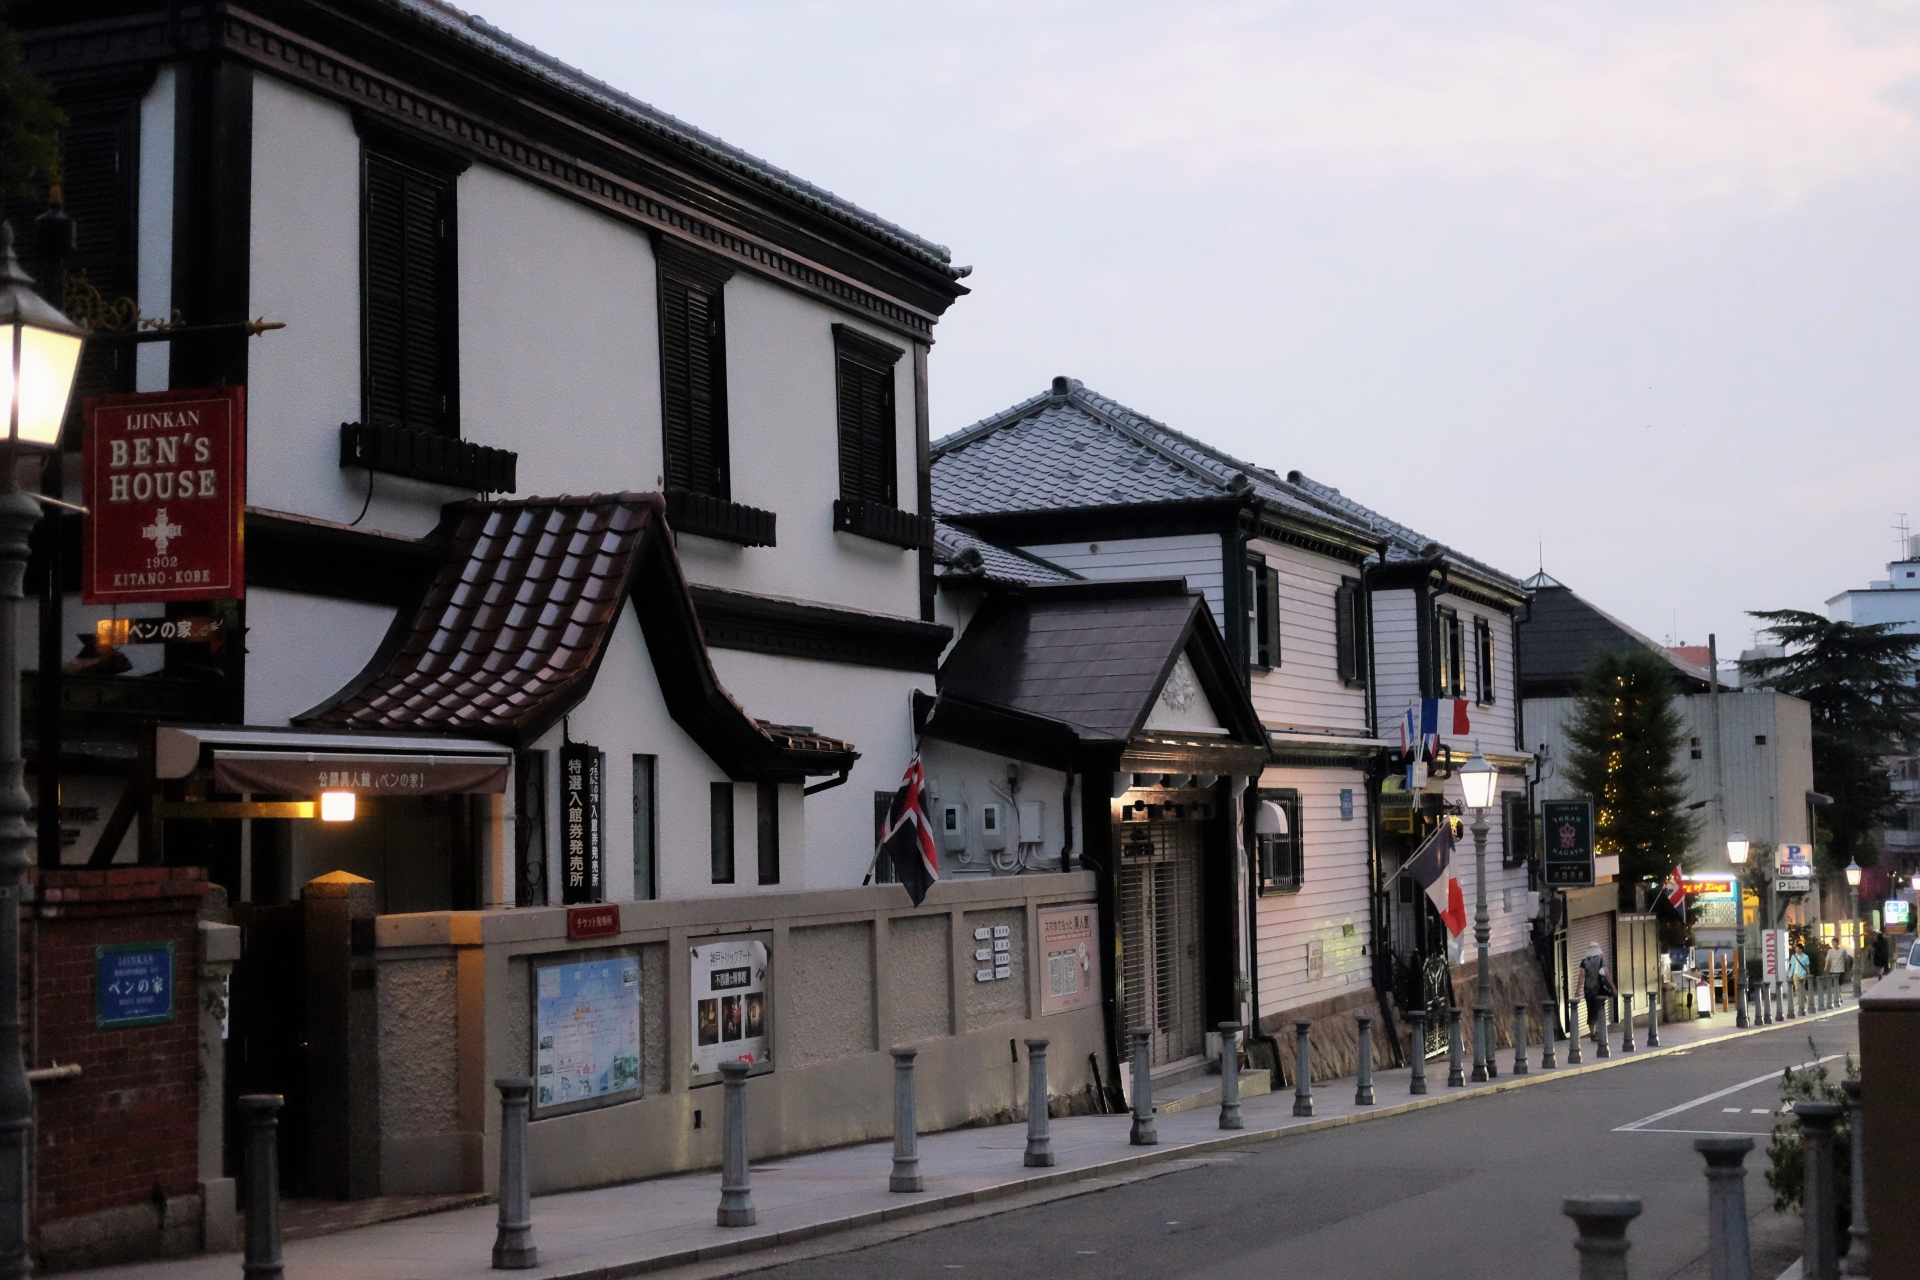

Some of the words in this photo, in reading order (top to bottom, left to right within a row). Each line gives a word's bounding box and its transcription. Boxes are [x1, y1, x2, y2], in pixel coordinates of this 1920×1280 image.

[126, 410, 201, 430] IJINKAN
[109, 433, 212, 468] BEN'S
[109, 469, 218, 503] HOUSE
[146, 556, 178, 569] 1902
[114, 572, 166, 586] KITANO
[175, 570, 210, 583] KOBE
[128, 620, 192, 639] ベンの家
[568, 758, 584, 887] 特選入館券発売所
[1553, 815, 1582, 823] YOKAN
[591, 805, 599, 887] 入館券発売所
[1551, 847, 1585, 856] NAGAYA
[1778, 881, 1786, 890] P
[709, 948, 752, 967] 神戸トリックアート
[1766, 933, 1776, 975] KIRIN
[108, 975, 164, 995] ベンの家
